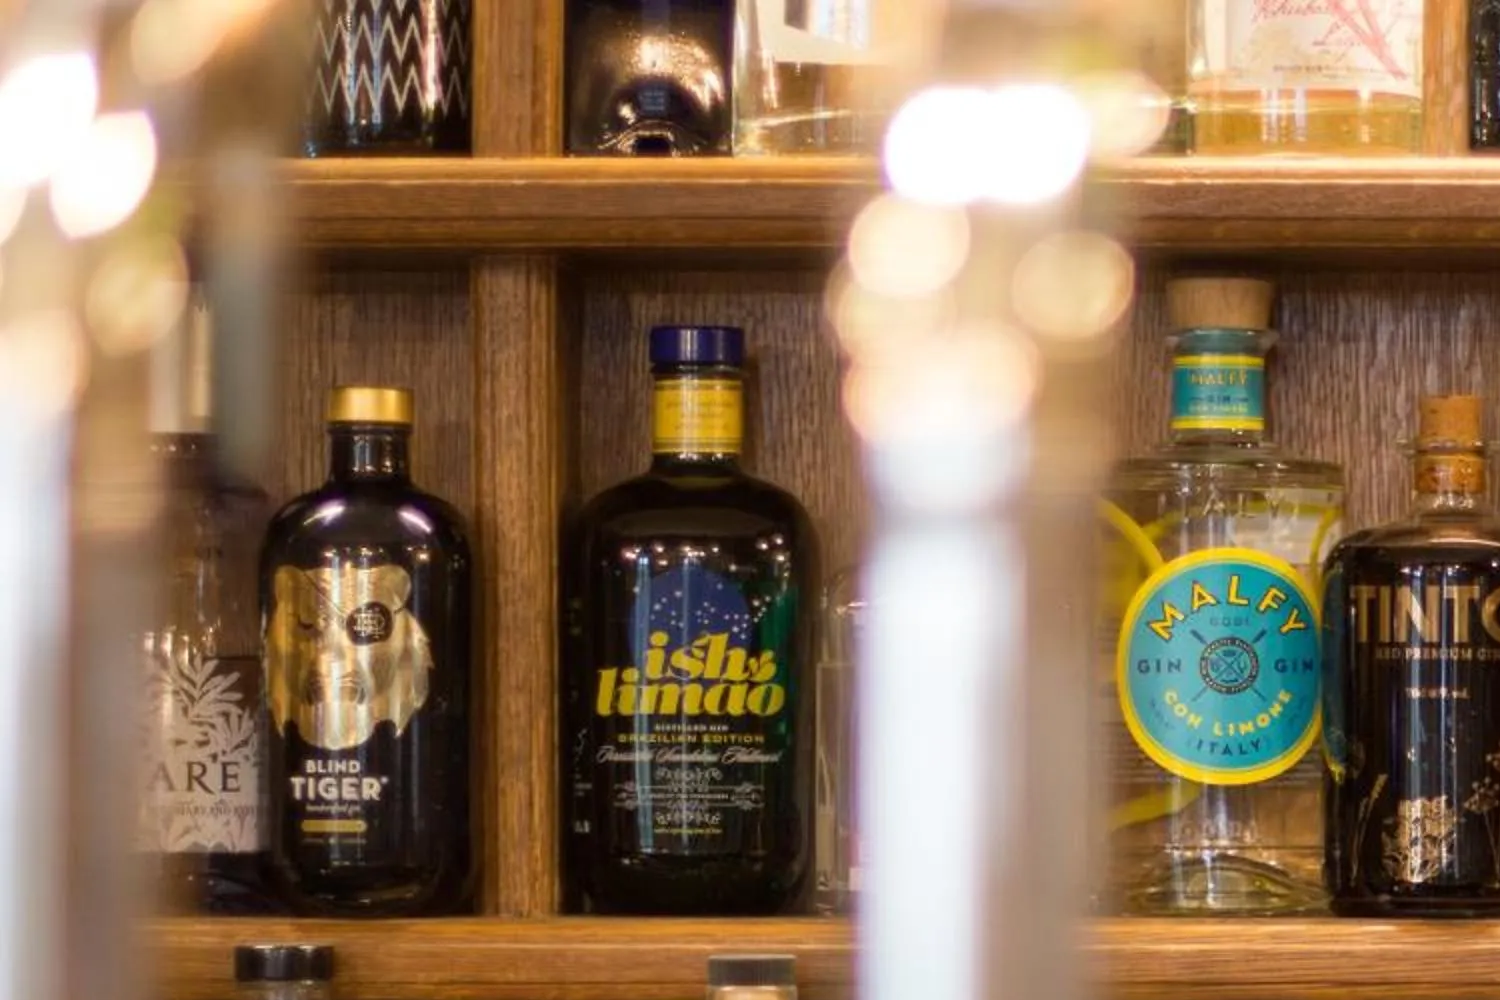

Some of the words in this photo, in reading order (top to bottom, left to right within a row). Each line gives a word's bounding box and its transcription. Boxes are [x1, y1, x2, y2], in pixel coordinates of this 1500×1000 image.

[1148, 575, 1306, 640] MALFY
[1137, 658, 1181, 674] GIN
[1274, 658, 1314, 673] GIN
[1164, 690, 1203, 729] CON
[617, 734, 698, 744] BRAZILIAN
[702, 734, 766, 744] EDITION
[1194, 738, 1262, 755] ITALY
[306, 759, 361, 774] BLIND
